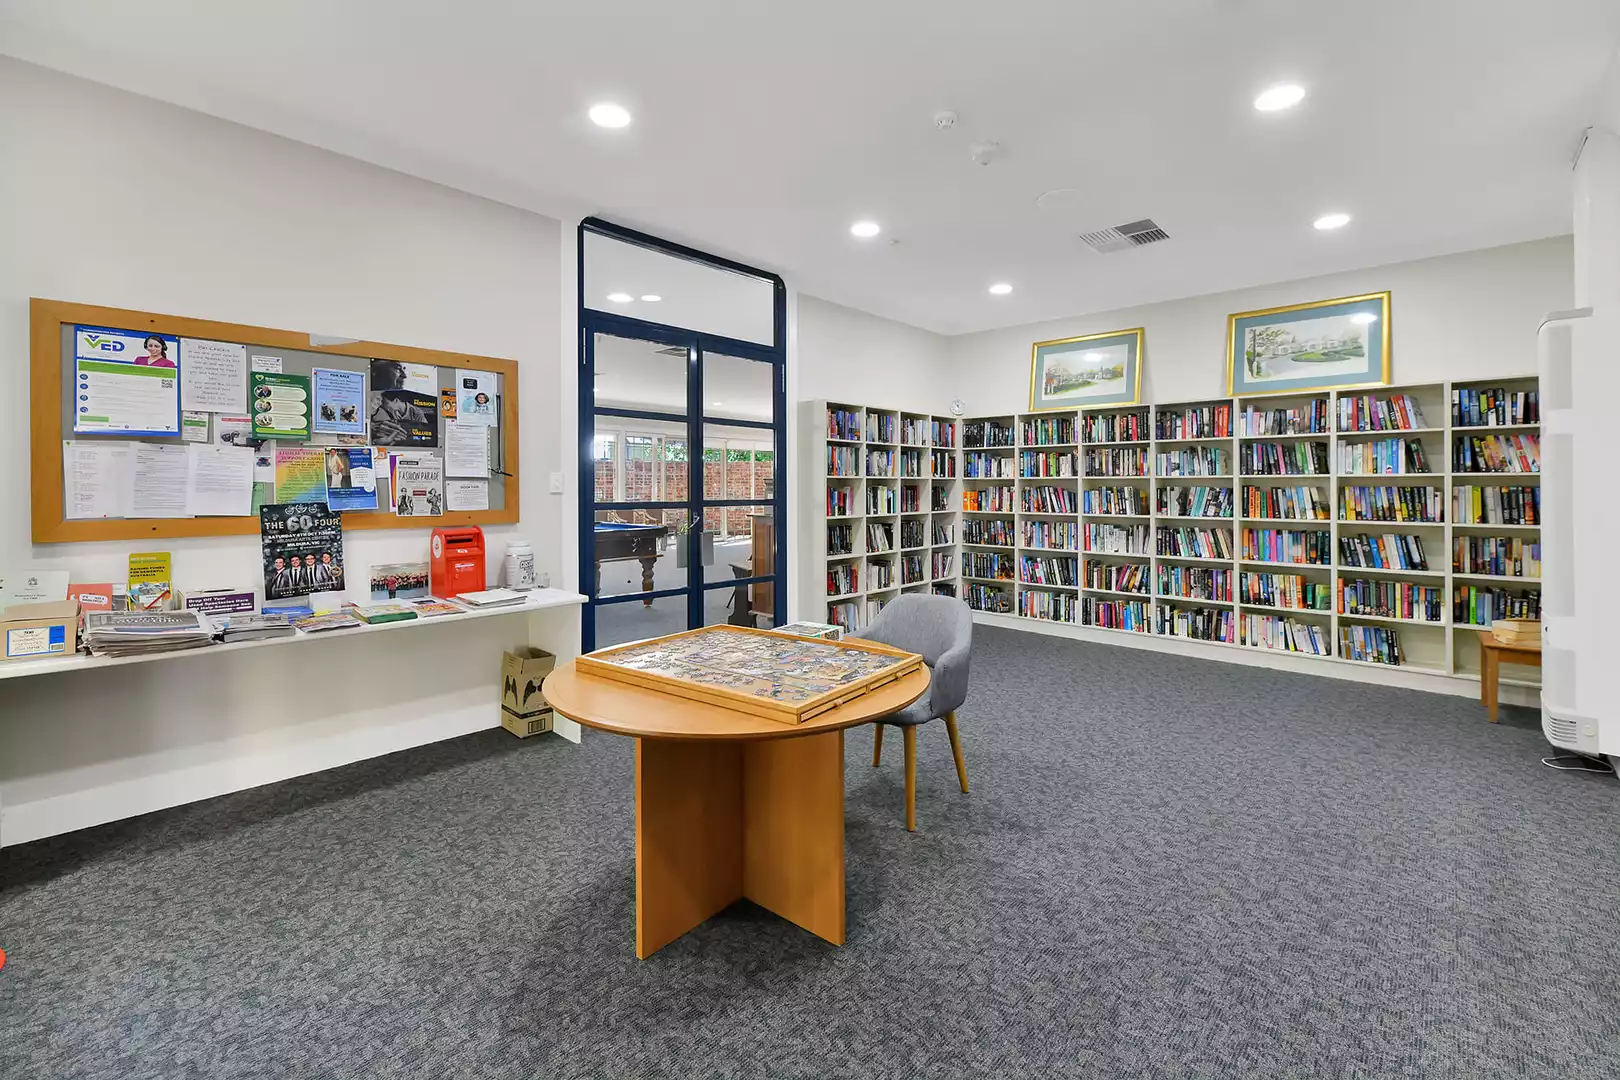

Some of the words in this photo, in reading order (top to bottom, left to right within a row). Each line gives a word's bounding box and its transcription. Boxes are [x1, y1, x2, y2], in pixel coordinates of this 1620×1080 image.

[414, 399, 436, 407] MISSION
[398, 470, 420, 481] FASHION
[420, 470, 440, 481] PARADE
[264, 521, 284, 530] THE
[286, 514, 314, 532] 60
[314, 517, 339, 528] FOUR
